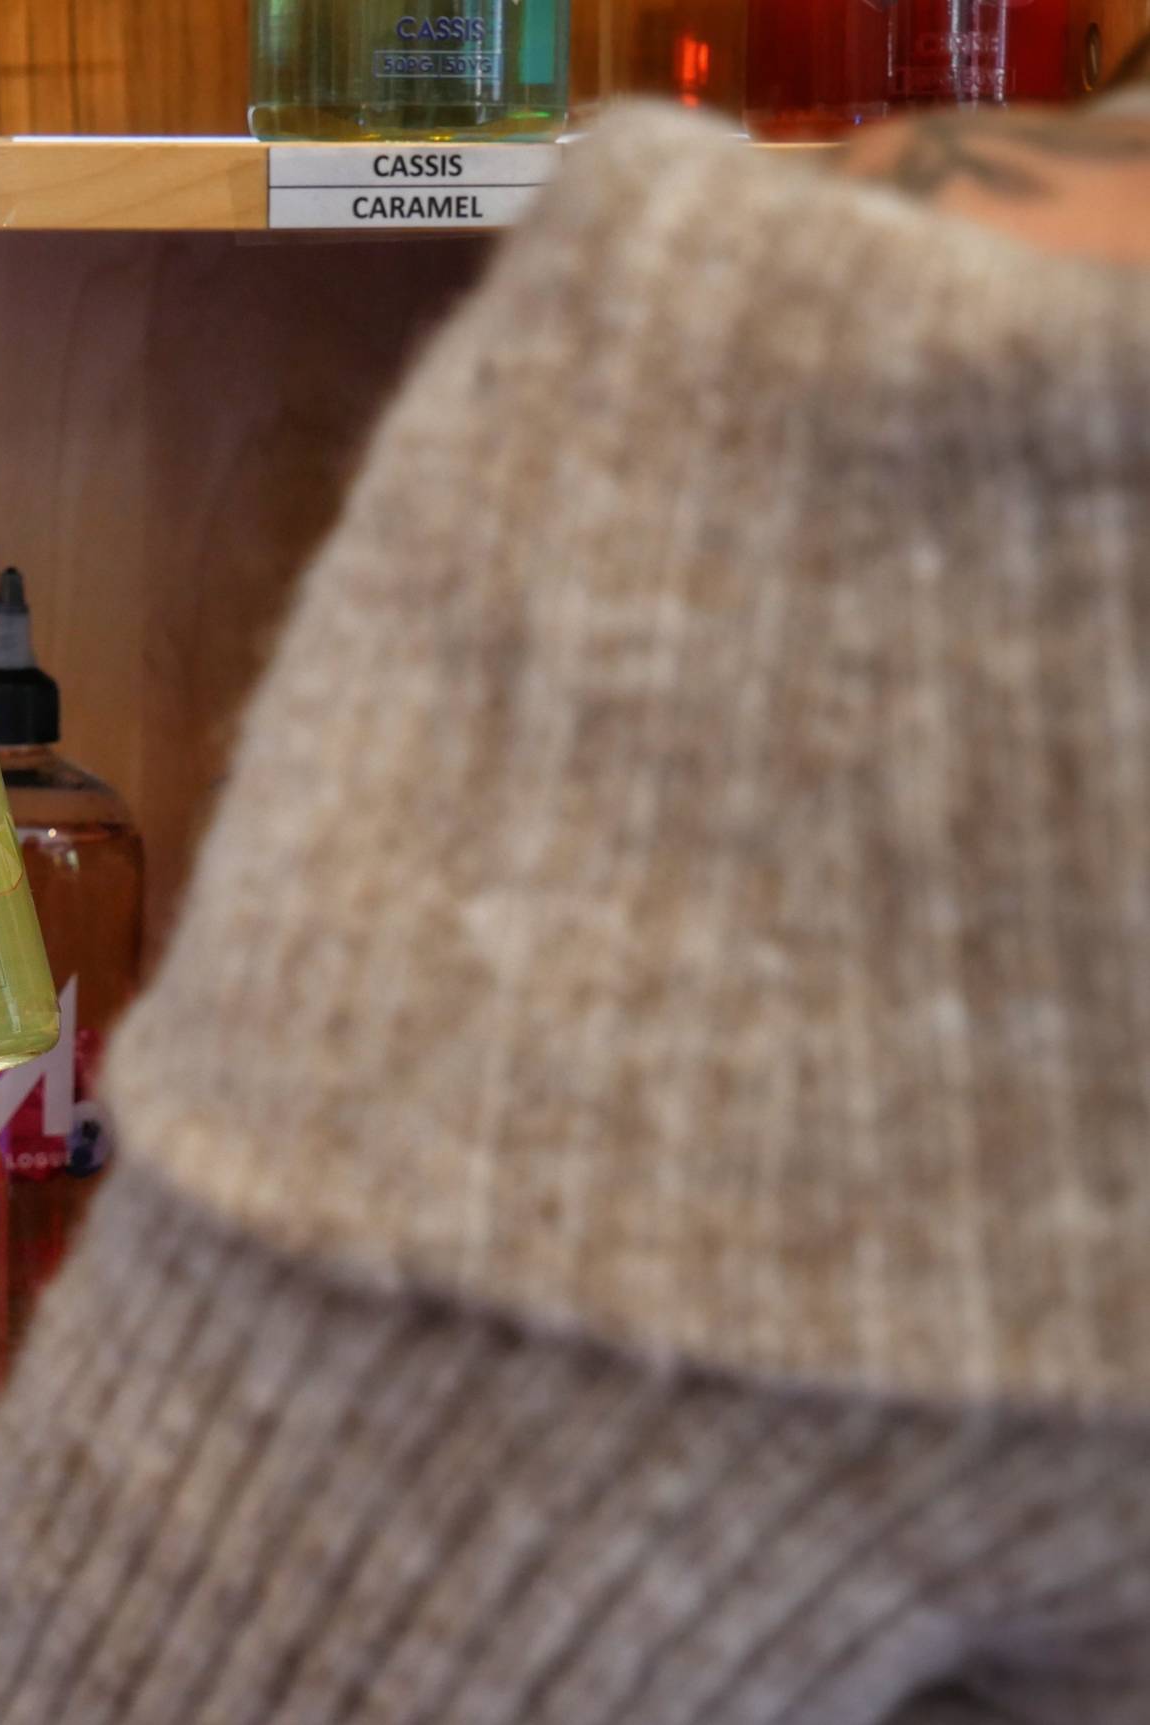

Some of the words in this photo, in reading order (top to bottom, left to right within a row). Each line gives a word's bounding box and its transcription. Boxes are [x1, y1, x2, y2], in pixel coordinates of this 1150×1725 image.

[396, 16, 485, 40] CASSIS
[384, 56, 434, 73] 50PG
[373, 154, 463, 178] CASSIS
[352, 195, 483, 219] CARAMEL
